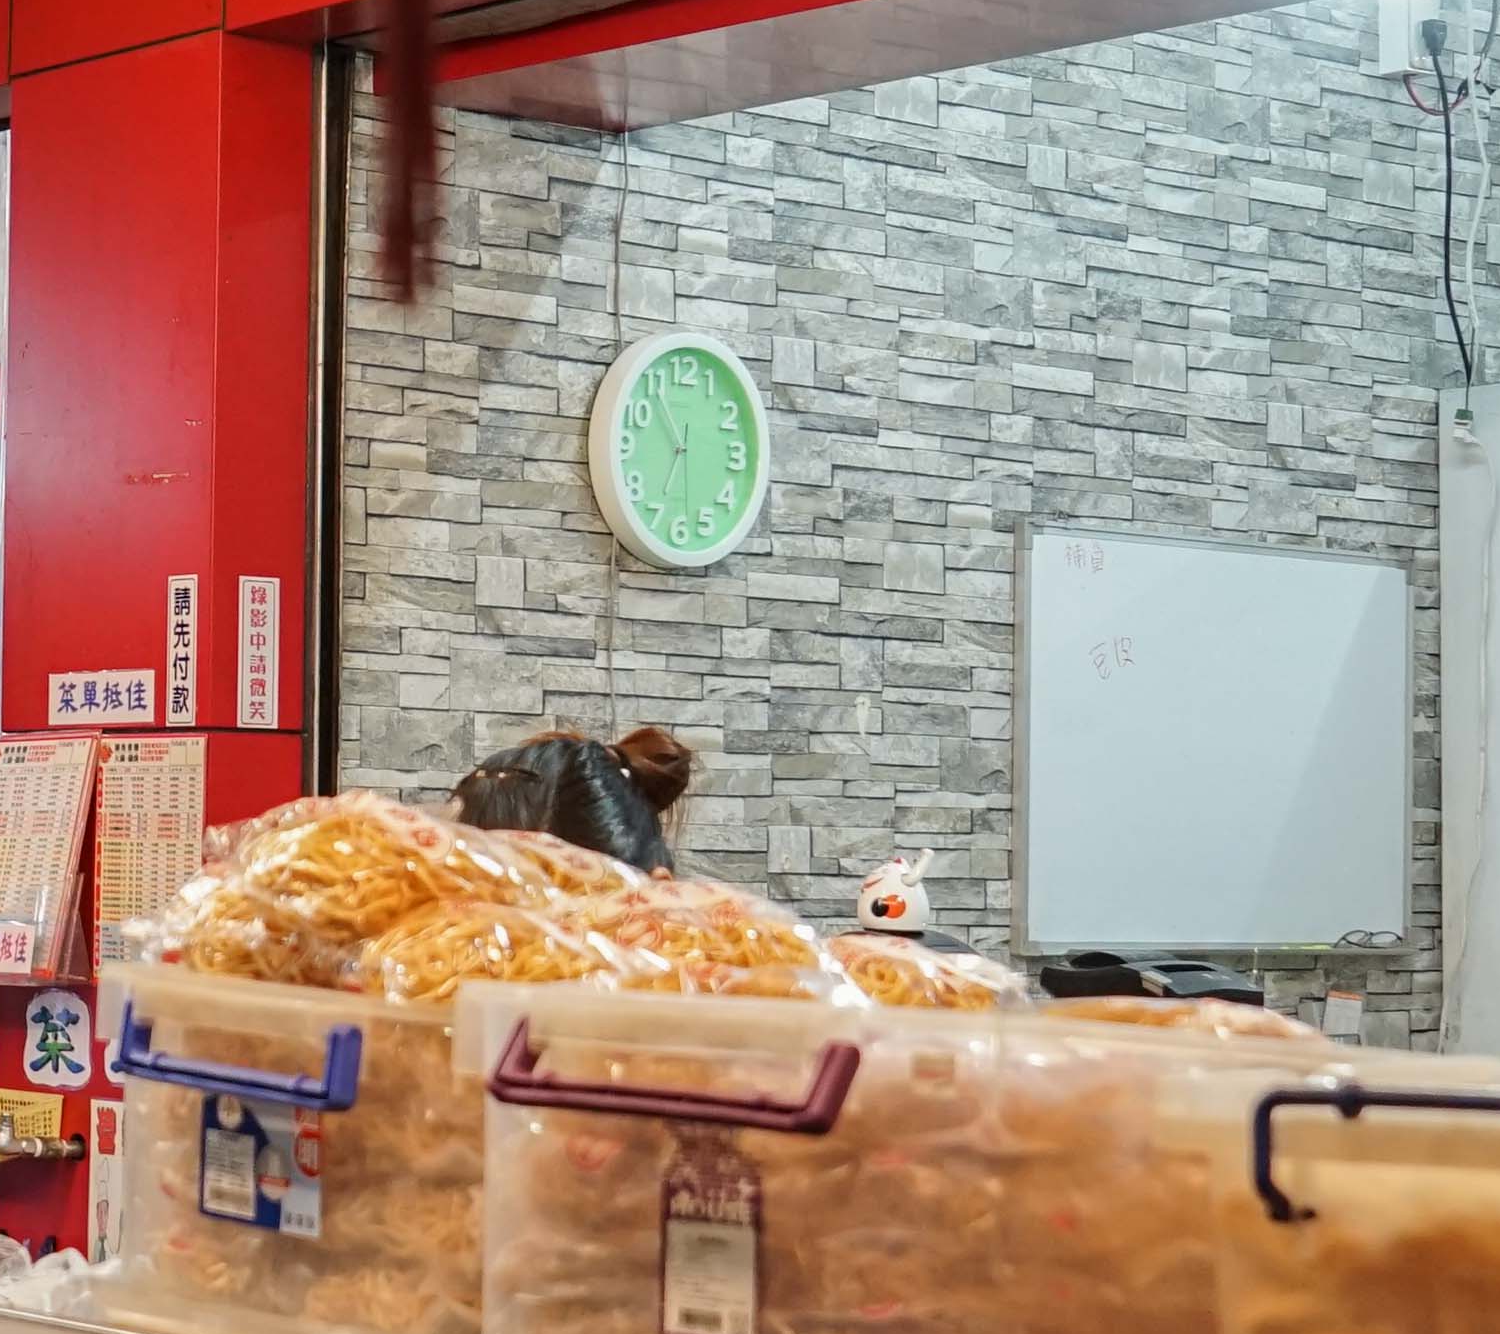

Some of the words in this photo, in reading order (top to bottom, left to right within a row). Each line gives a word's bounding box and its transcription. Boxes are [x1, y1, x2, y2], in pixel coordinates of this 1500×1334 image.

[642, 369, 666, 396] 11
[670, 355, 699, 387] 12
[702, 370, 716, 396] 1
[624, 399, 651, 428] 10
[720, 401, 739, 431] 2
[620, 433, 635, 460] 9
[727, 442, 747, 471] 3
[625, 470, 645, 502] 8
[715, 480, 736, 511] 4
[647, 503, 665, 531] 7
[670, 516, 690, 545] 6
[697, 507, 716, 537] 5
[172, 587, 192, 715] 請先付款
[248, 585, 268, 721] 錄影中請微笑
